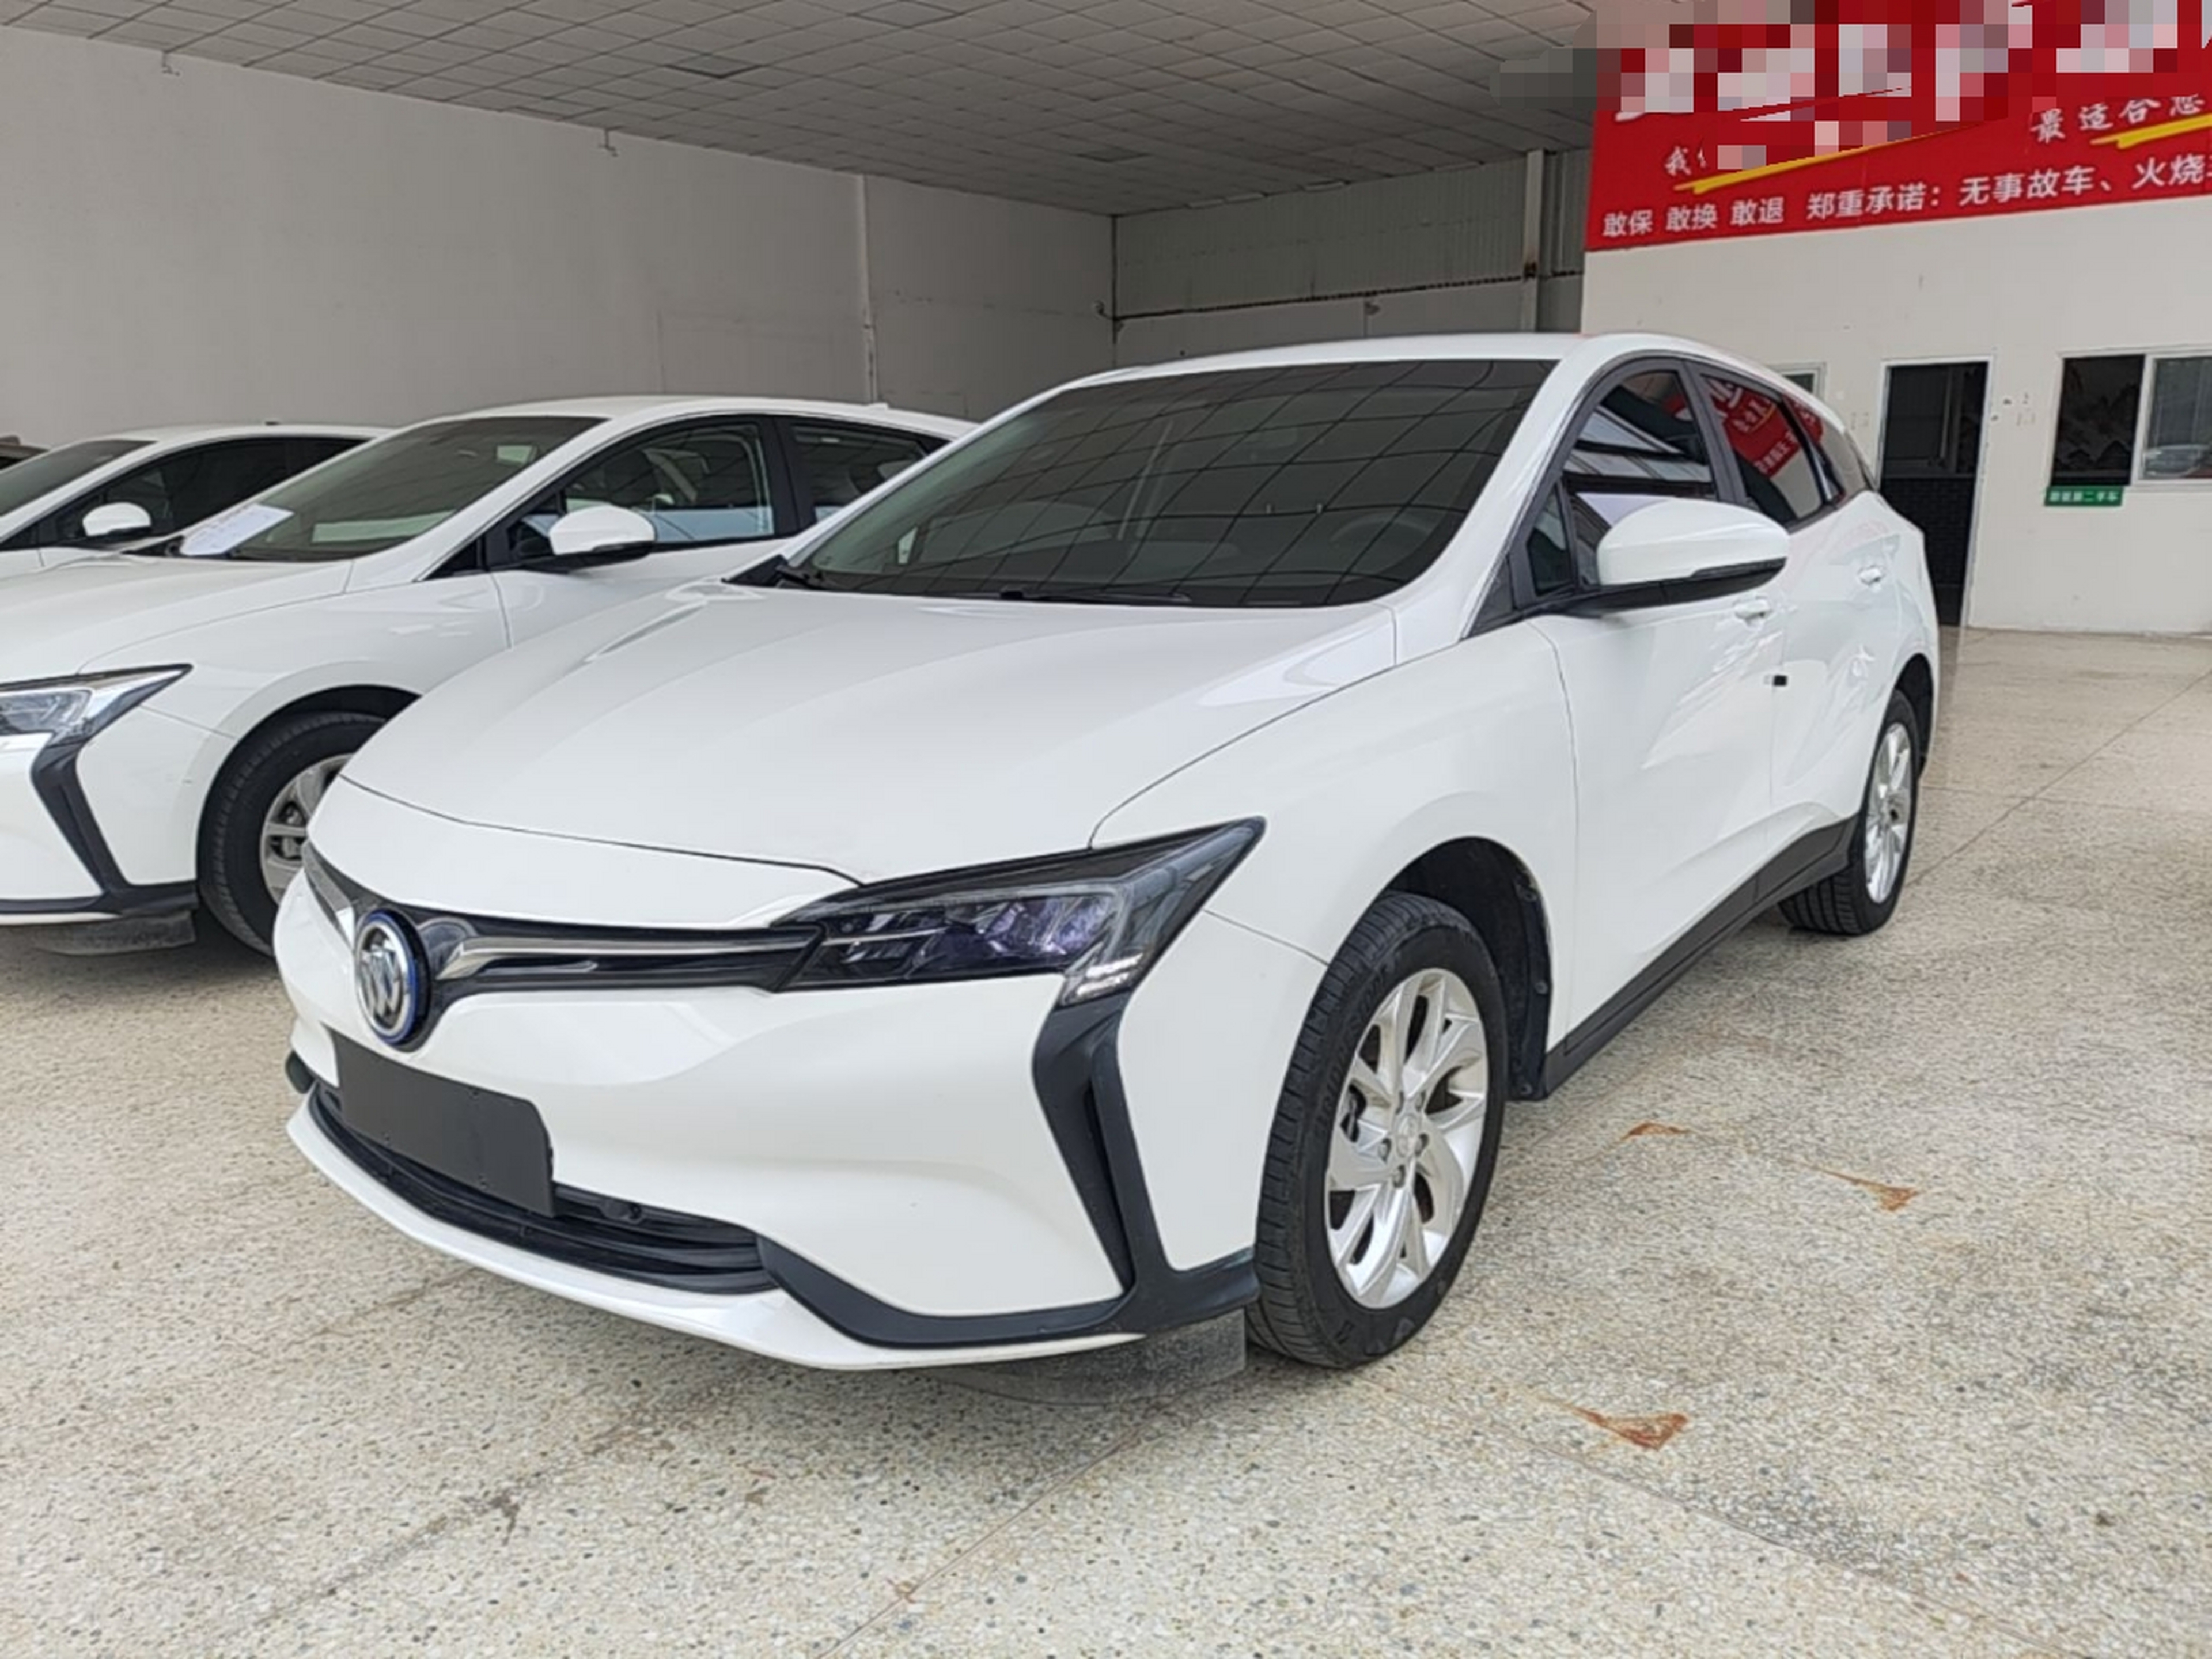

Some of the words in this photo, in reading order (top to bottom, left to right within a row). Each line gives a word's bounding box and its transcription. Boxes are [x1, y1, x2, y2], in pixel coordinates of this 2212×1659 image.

[1602, 209, 1653, 237] 敢保
[1665, 203, 1719, 232] 敢换
[1730, 197, 1784, 226] 敢退
